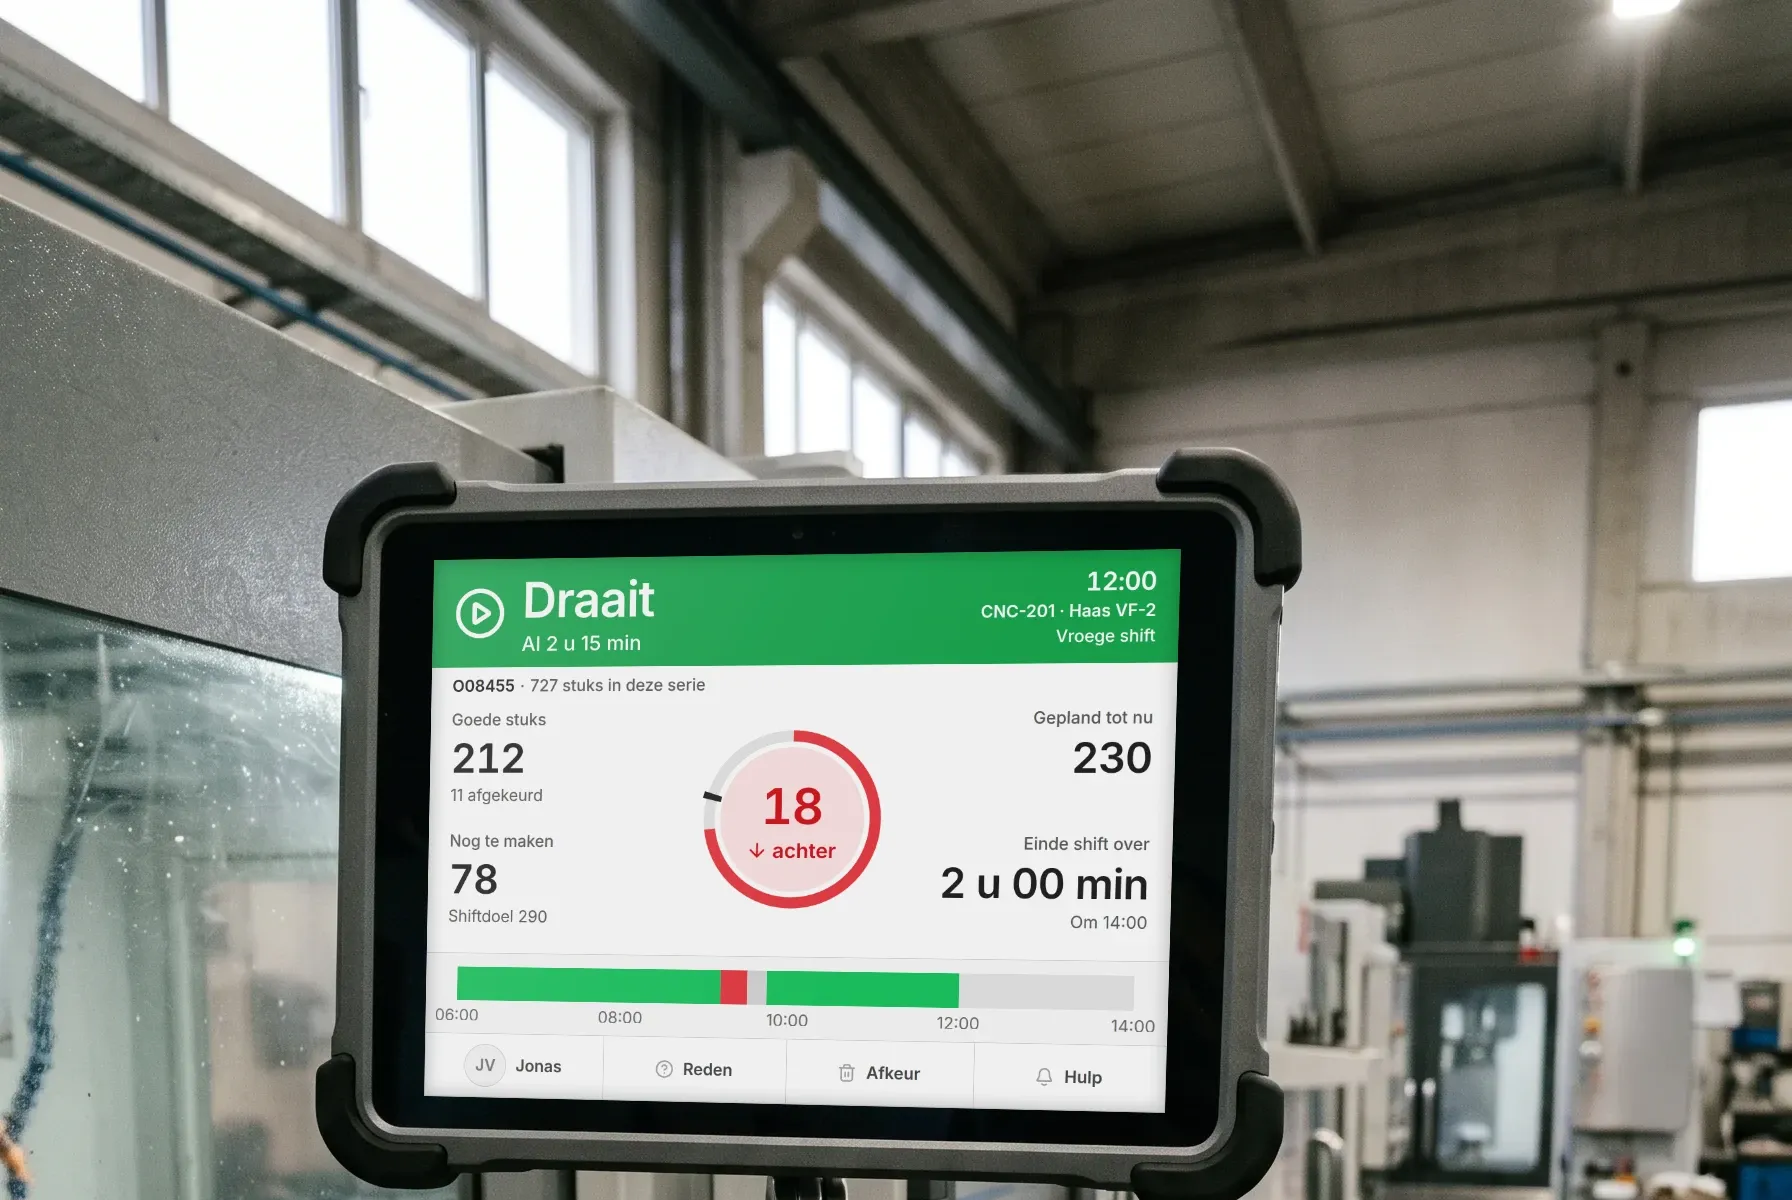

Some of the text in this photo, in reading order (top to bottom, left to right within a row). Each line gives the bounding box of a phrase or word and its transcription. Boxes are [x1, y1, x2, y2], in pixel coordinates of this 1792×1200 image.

[1087, 570, 1157, 592] 12:00
[524, 578, 655, 619] Draait
[980, 602, 1156, 619] CNC-201 Haas VF-2
[521, 634, 641, 652] Al 2 u 15 min
[1055, 627, 1156, 646] Vroege shift
[530, 678, 559, 693] 727
[562, 678, 604, 692] stuks
[608, 678, 621, 692] in
[625, 677, 664, 692] deze
[667, 677, 706, 692] serie
[452, 712, 547, 727] Goede stuks
[1033, 710, 1153, 728] Gepland tot nu
[453, 742, 524, 774] 212
[1073, 741, 1152, 774] 230
[450, 787, 543, 805] 11 afgekeurd
[764, 786, 822, 826] 18
[450, 833, 554, 851] Nog te maken
[772, 842, 837, 859] achter
[1024, 836, 1151, 851] Einde shift over
[451, 863, 498, 895] 78
[941, 866, 1148, 901] 2 u 00 min
[448, 908, 548, 924] Shiftdoel 290
[1070, 915, 1148, 930] Om 14:00
[435, 1007, 479, 1021] 06:00
[598, 1010, 643, 1024] 08:00
[766, 1013, 809, 1027] 10:00
[936, 1016, 980, 1030] 12:00
[1111, 1019, 1156, 1033] 14:00
[475, 1058, 496, 1072] JV
[515, 1058, 562, 1073] Jonas
[683, 1062, 733, 1077] Reden
[866, 1065, 921, 1081] Afkeur
[1064, 1069, 1103, 1087] Hulp
